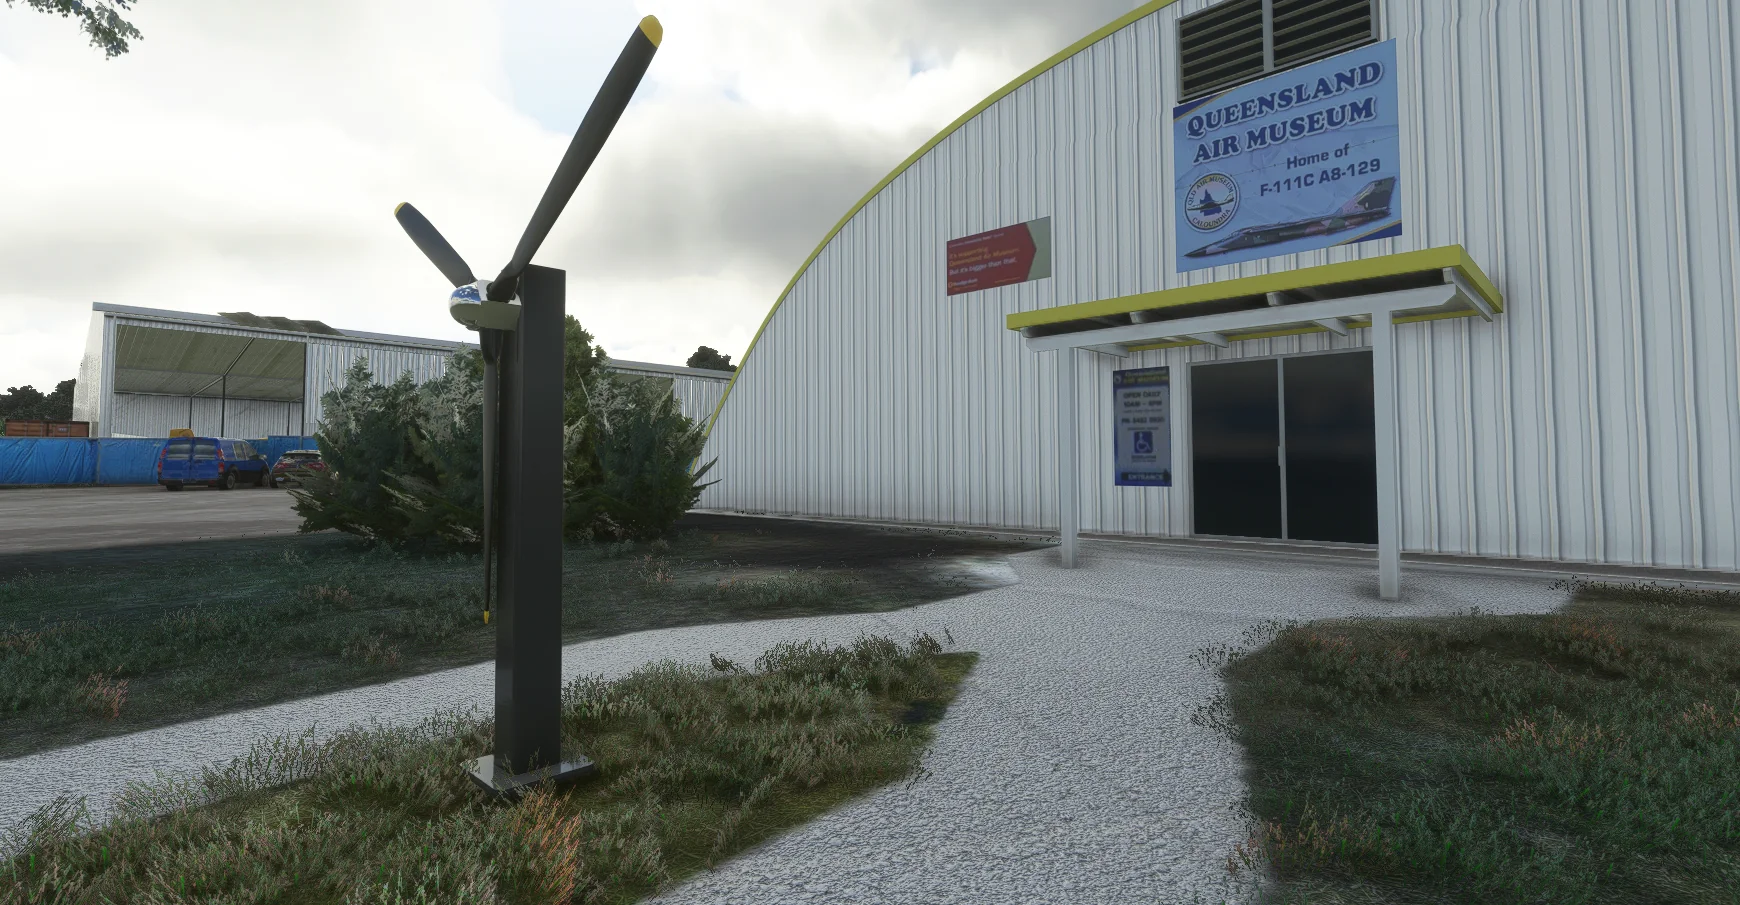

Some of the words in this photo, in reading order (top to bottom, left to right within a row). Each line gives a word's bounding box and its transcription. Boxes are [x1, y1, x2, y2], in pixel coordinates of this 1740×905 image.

[1187, 61, 1383, 138] QUEENSLAND
[1193, 134, 1241, 164] AIR
[1246, 97, 1376, 150] MUSEUM
[1286, 150, 1329, 170] Home
[1334, 143, 1350, 159] of
[1187, 190, 1198, 206] QLD
[1196, 179, 1209, 191] AIR
[1209, 176, 1234, 194] MUSEUM
[1260, 174, 1315, 197] F-111C
[1319, 158, 1381, 184] A8-129
[1192, 209, 1231, 228] CALOUNDRA
